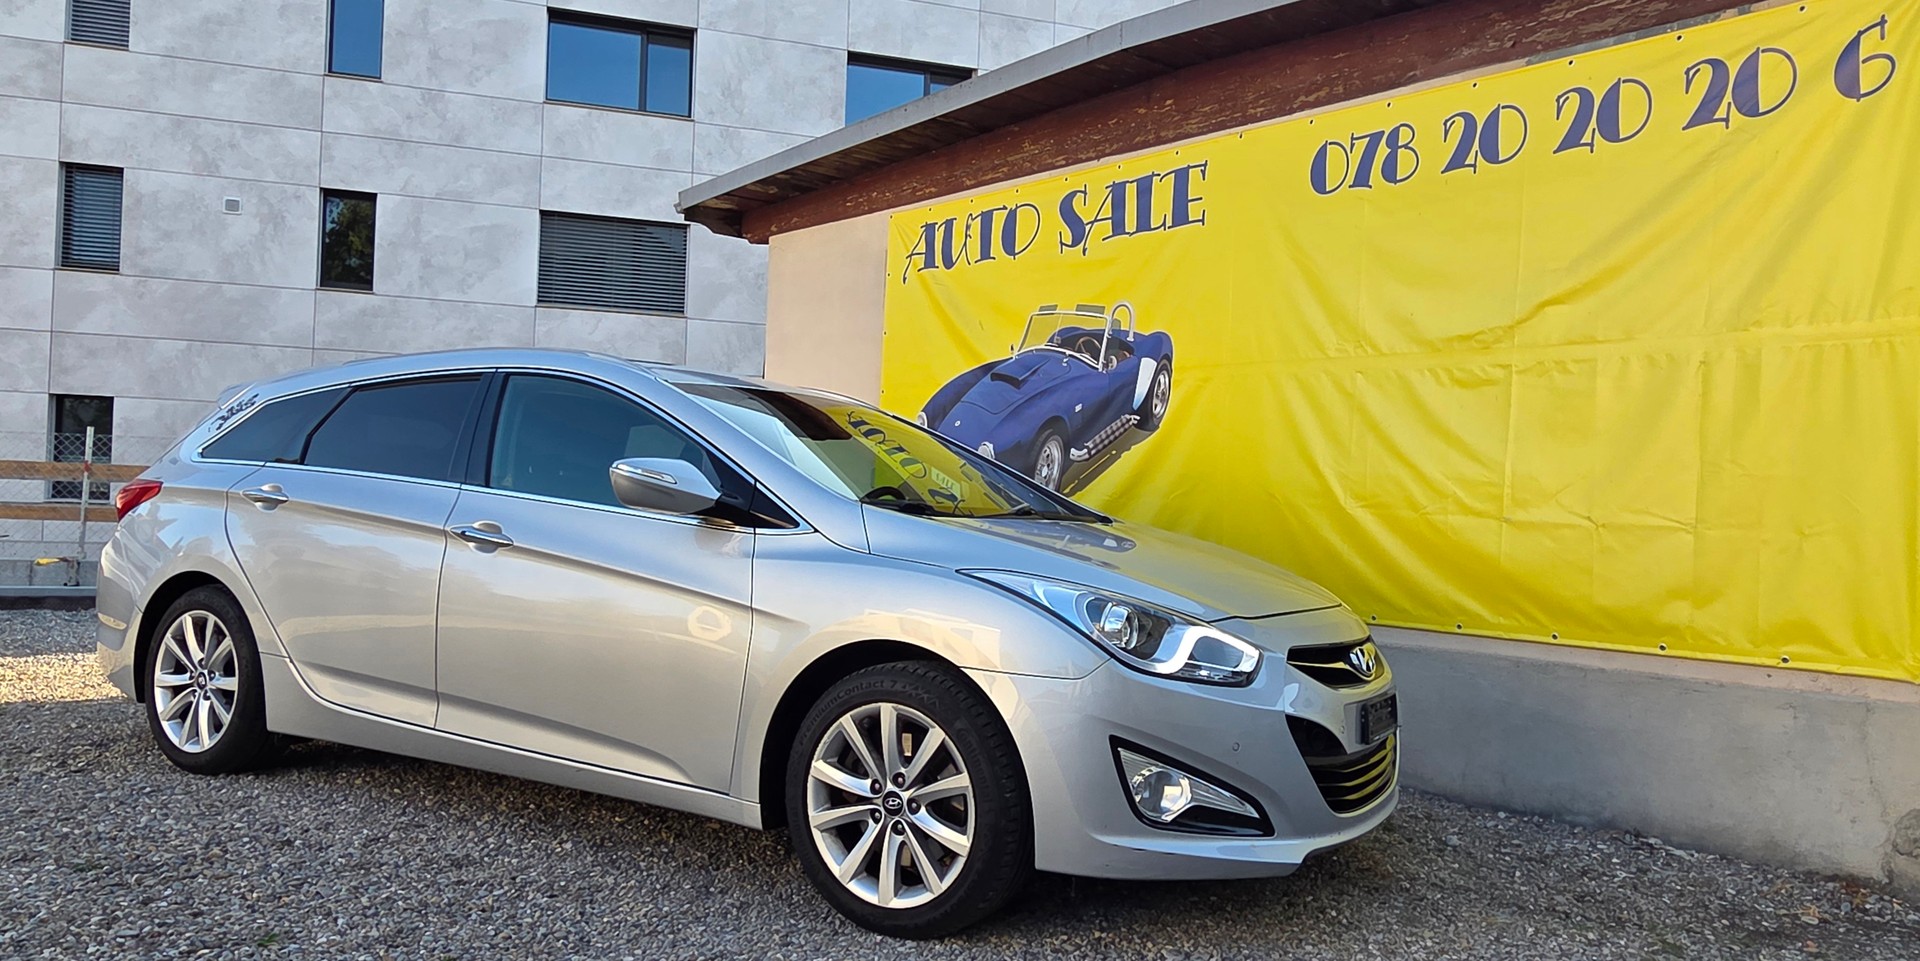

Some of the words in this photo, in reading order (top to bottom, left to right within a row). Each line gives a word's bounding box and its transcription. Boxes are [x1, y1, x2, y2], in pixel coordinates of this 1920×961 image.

[1310, 122, 1419, 195] 078
[1440, 103, 1528, 174] 20
[1552, 77, 1653, 154] 20
[1681, 46, 1798, 130] 20
[1834, 14, 1896, 102] 6
[903, 203, 1040, 284] AUTO
[1059, 160, 1208, 256] SALE
[799, 680, 885, 746] PremiumContact
[890, 680, 899, 689] 7
